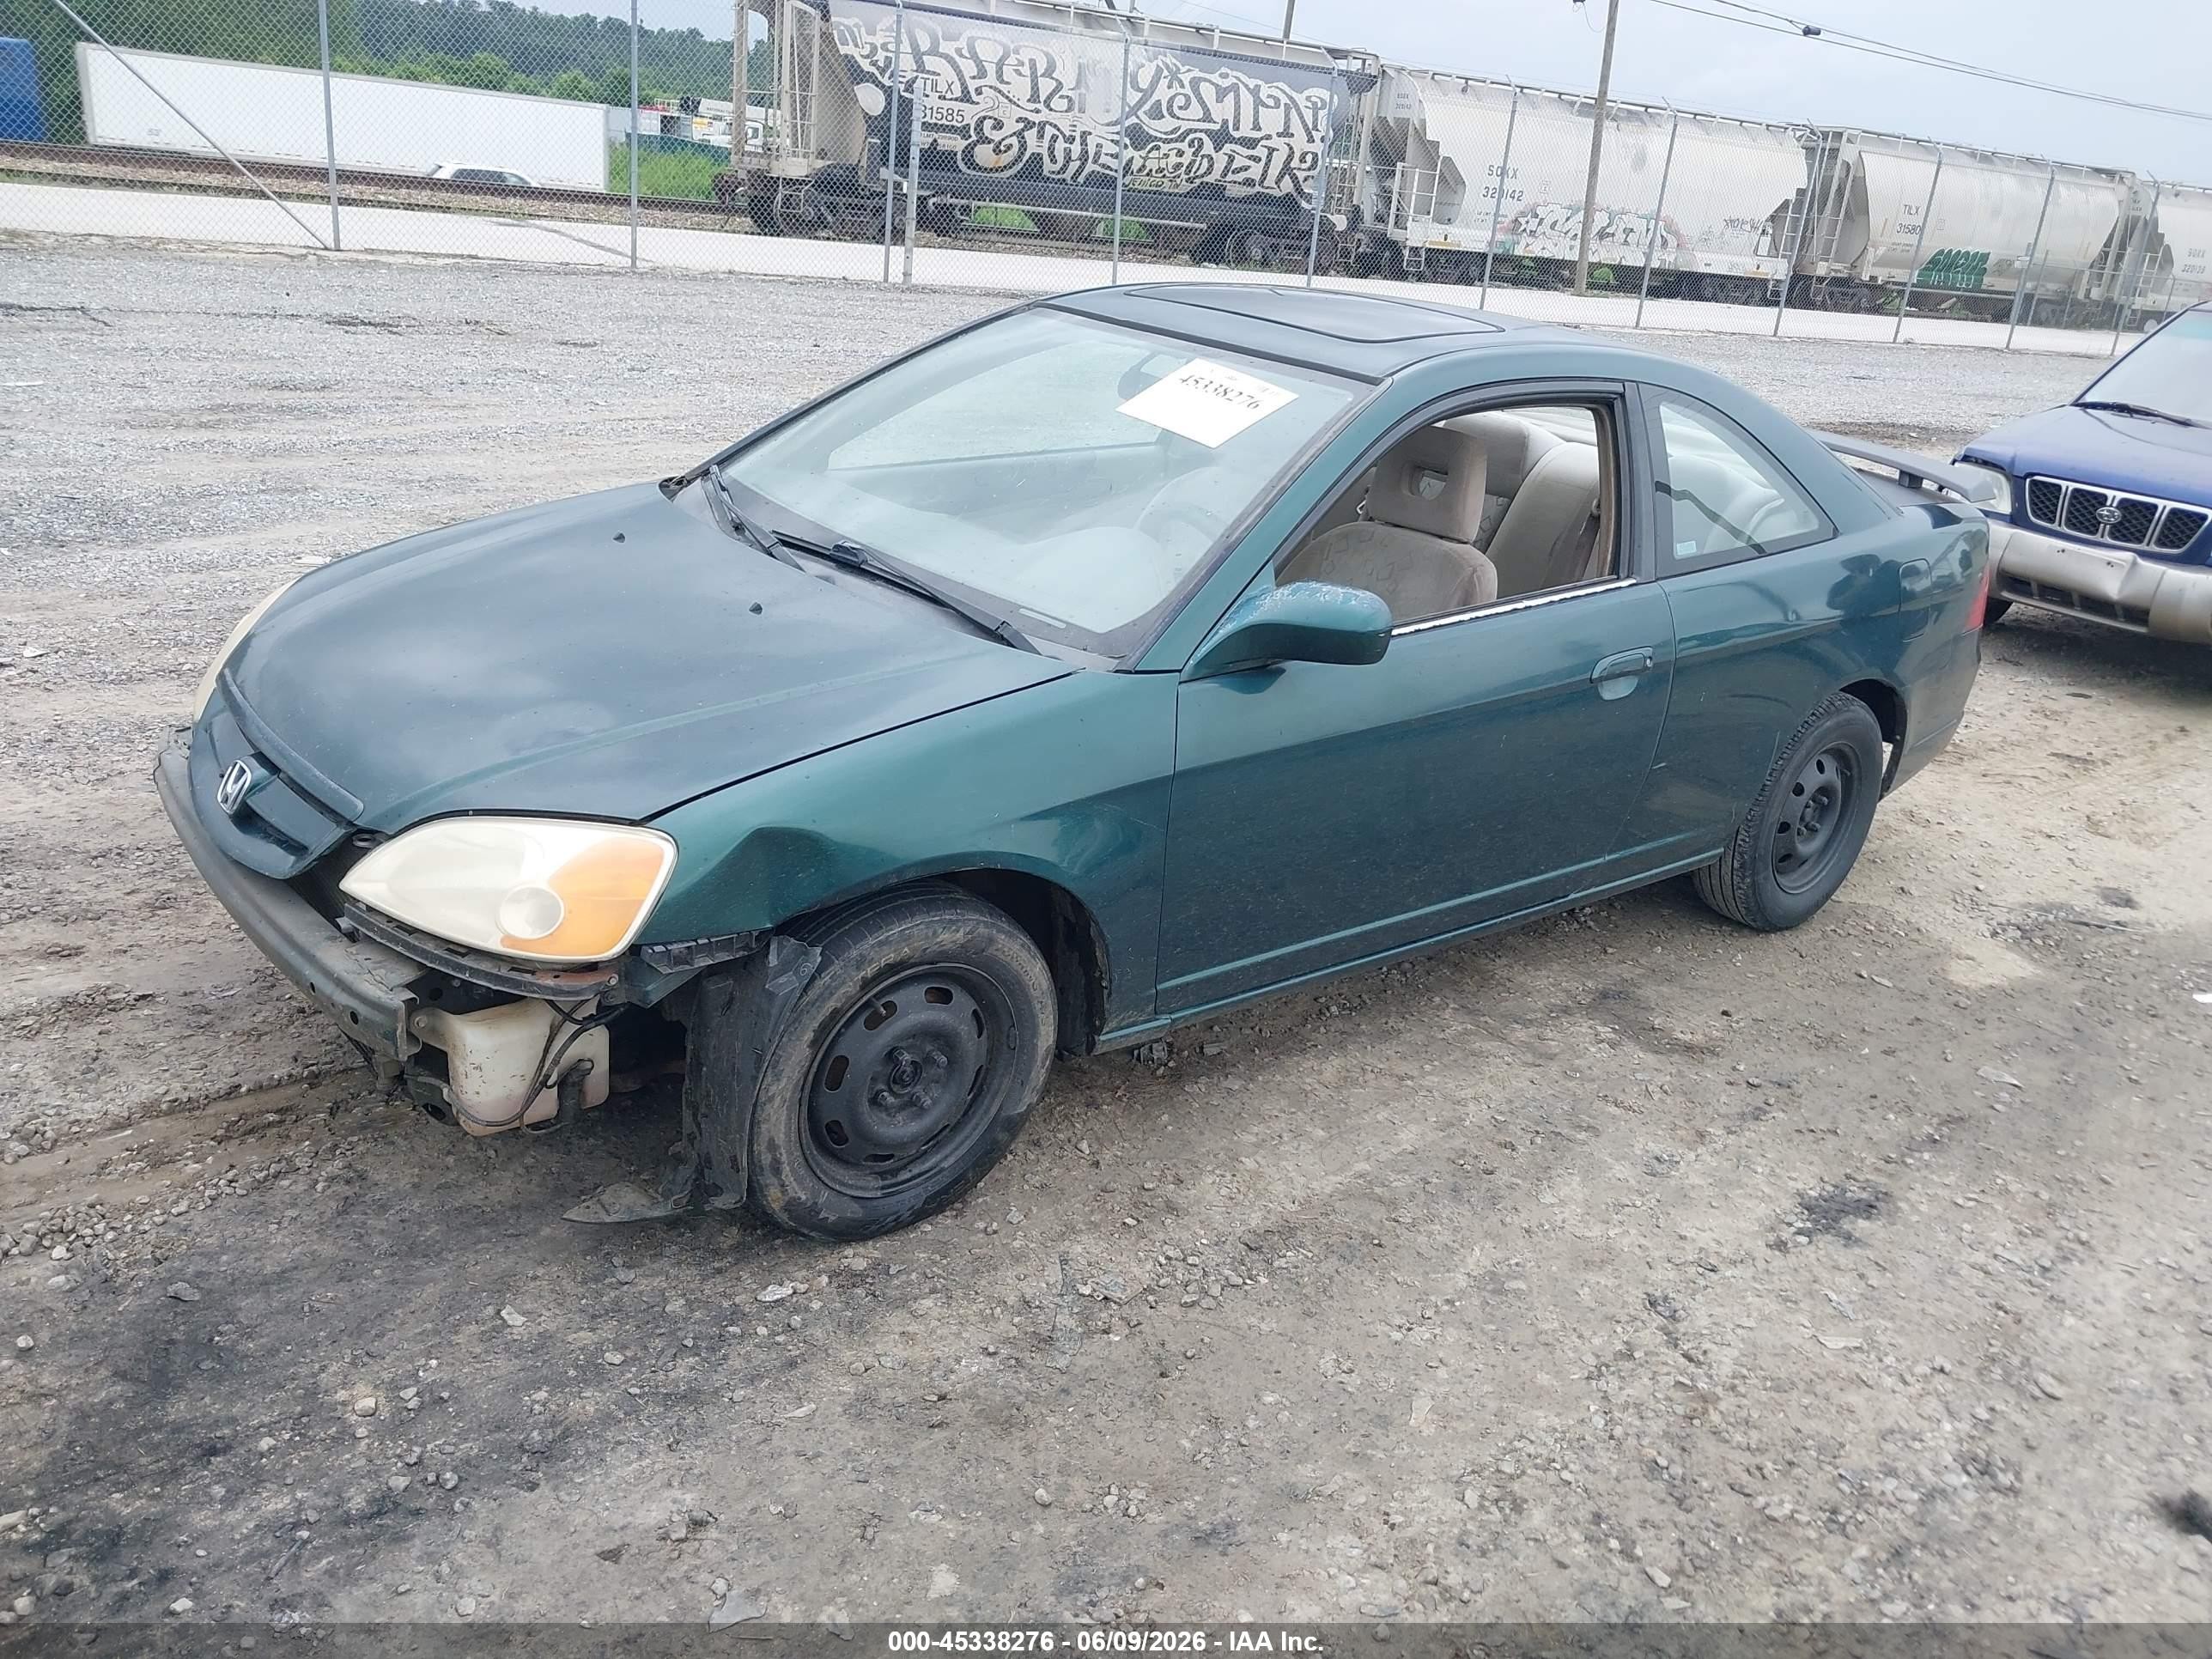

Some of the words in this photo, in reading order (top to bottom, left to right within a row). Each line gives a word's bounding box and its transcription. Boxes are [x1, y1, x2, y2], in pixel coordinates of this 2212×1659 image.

[920, 77, 955, 96] TILX
[1904, 204, 1922, 216] TILX
[1896, 223, 1923, 235] 31580
[1180, 374, 1264, 410] 45338276
